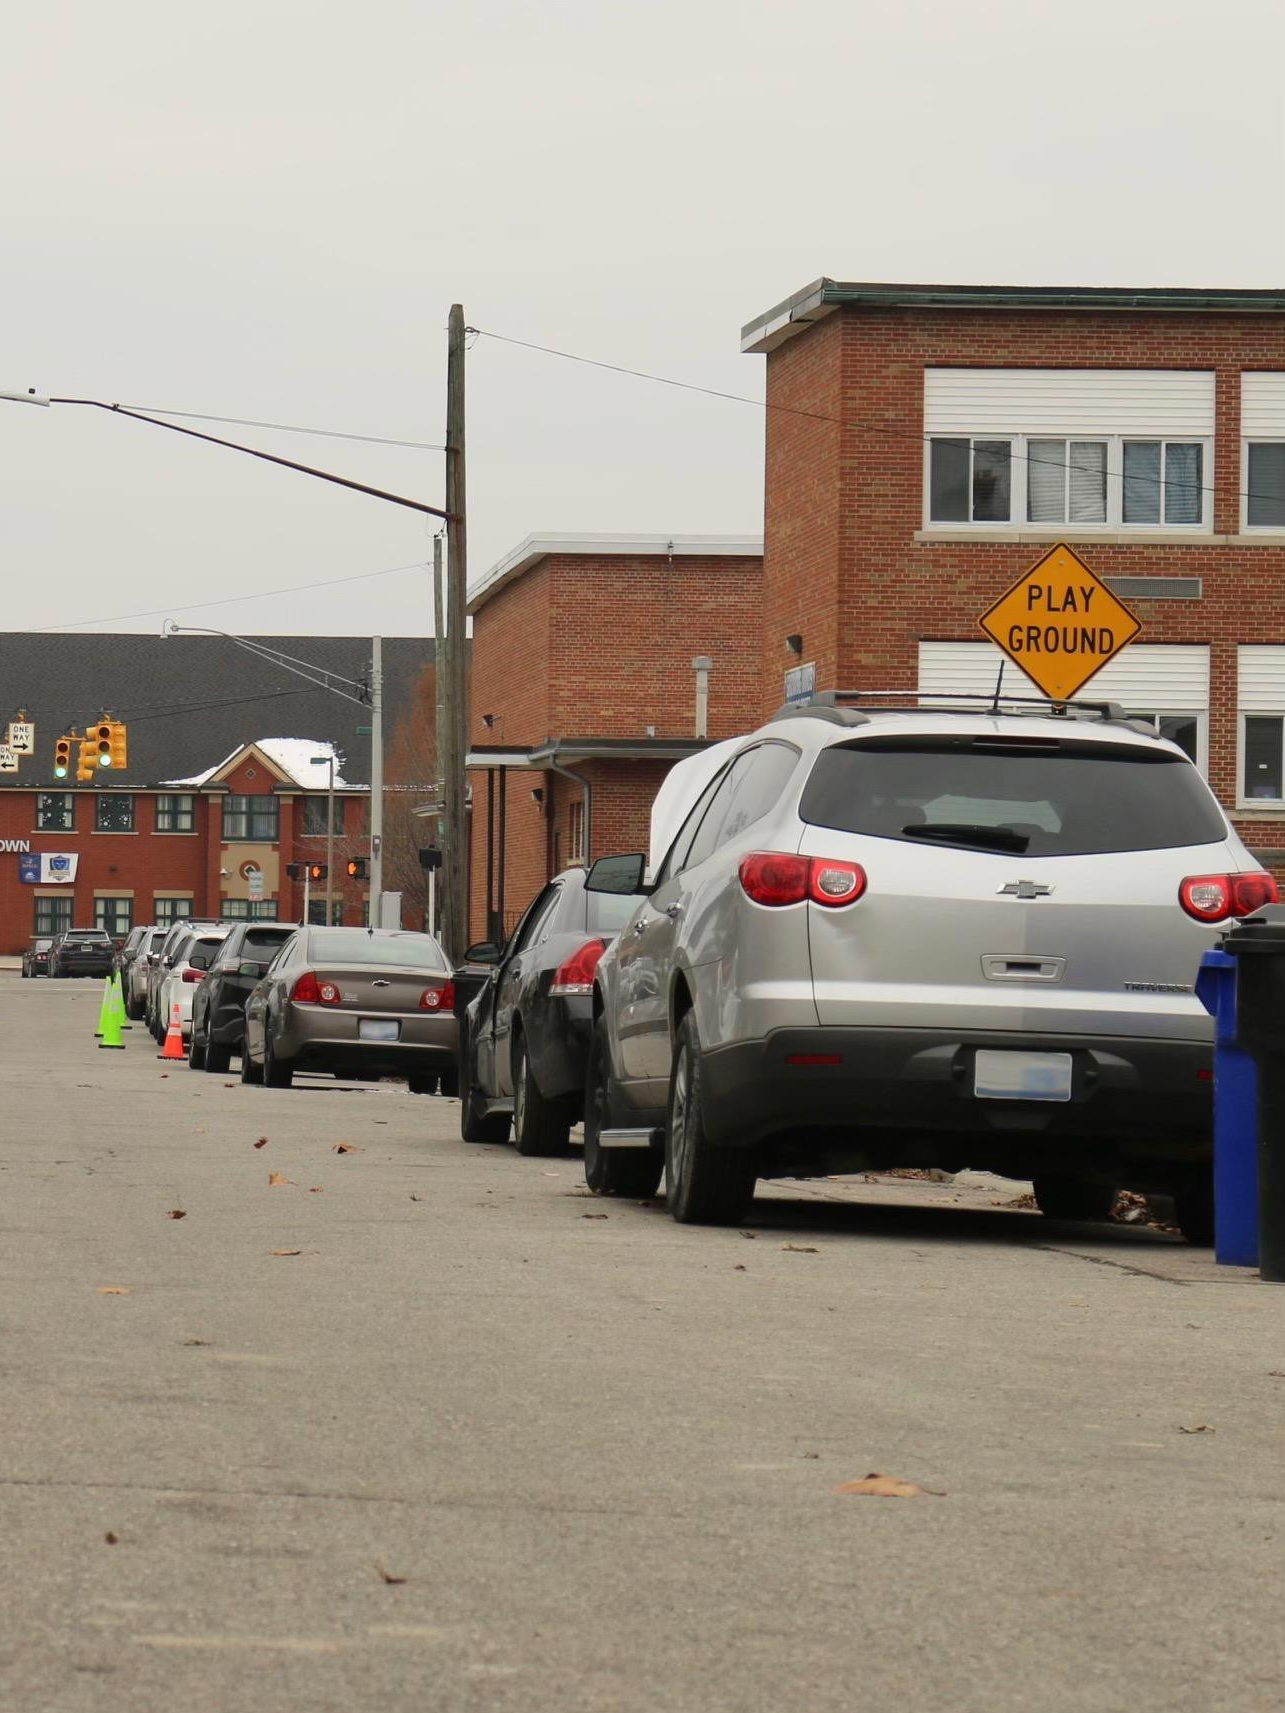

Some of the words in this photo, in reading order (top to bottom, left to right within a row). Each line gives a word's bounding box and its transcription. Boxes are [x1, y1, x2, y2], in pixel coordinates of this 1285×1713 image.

[1028, 584, 1095, 613] PLAY
[1008, 625, 1114, 654] GROUND
[1123, 981, 1194, 993] TRAVERSE
